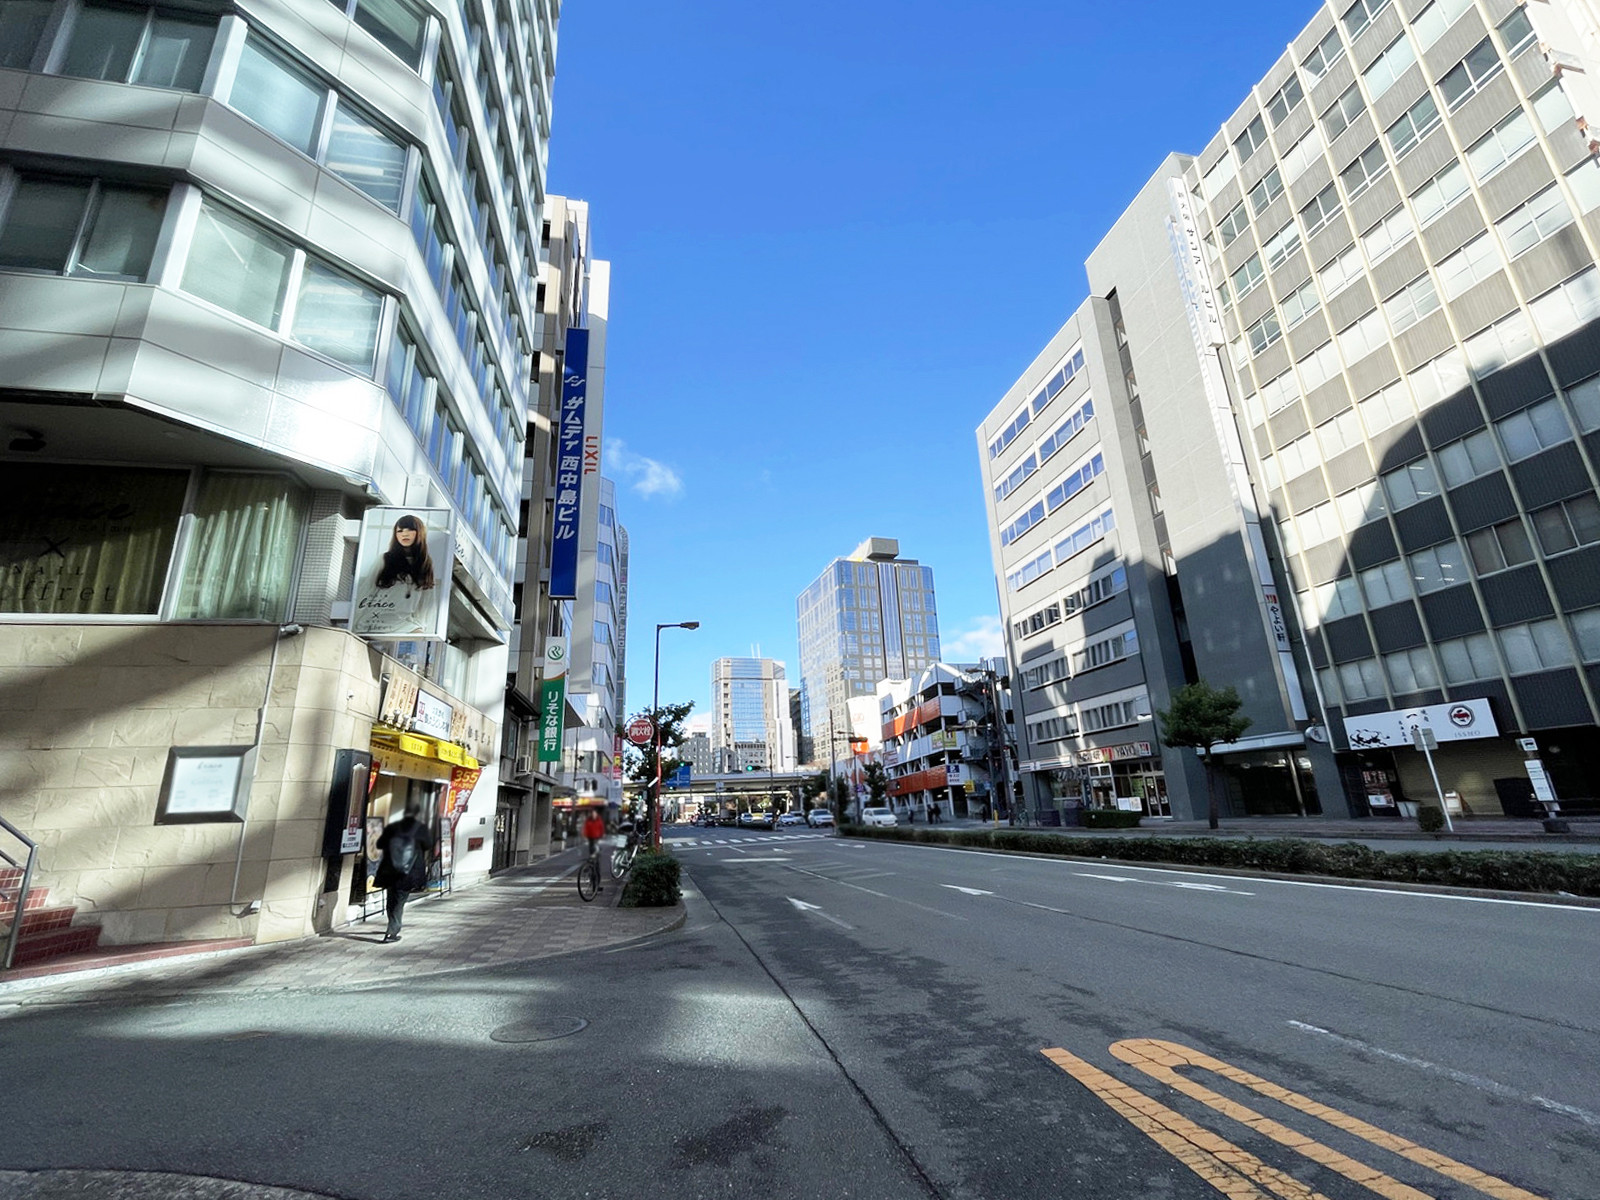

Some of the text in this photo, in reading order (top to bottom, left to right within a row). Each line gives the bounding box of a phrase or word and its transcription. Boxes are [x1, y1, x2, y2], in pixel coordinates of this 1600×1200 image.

[555, 395, 584, 540] サムティ西中島ビル
[584, 435, 598, 475] LIXIL
[543, 690, 559, 751] りそな銀行
[631, 726, 651, 737] 消火栓
[454, 770, 479, 782] 355
